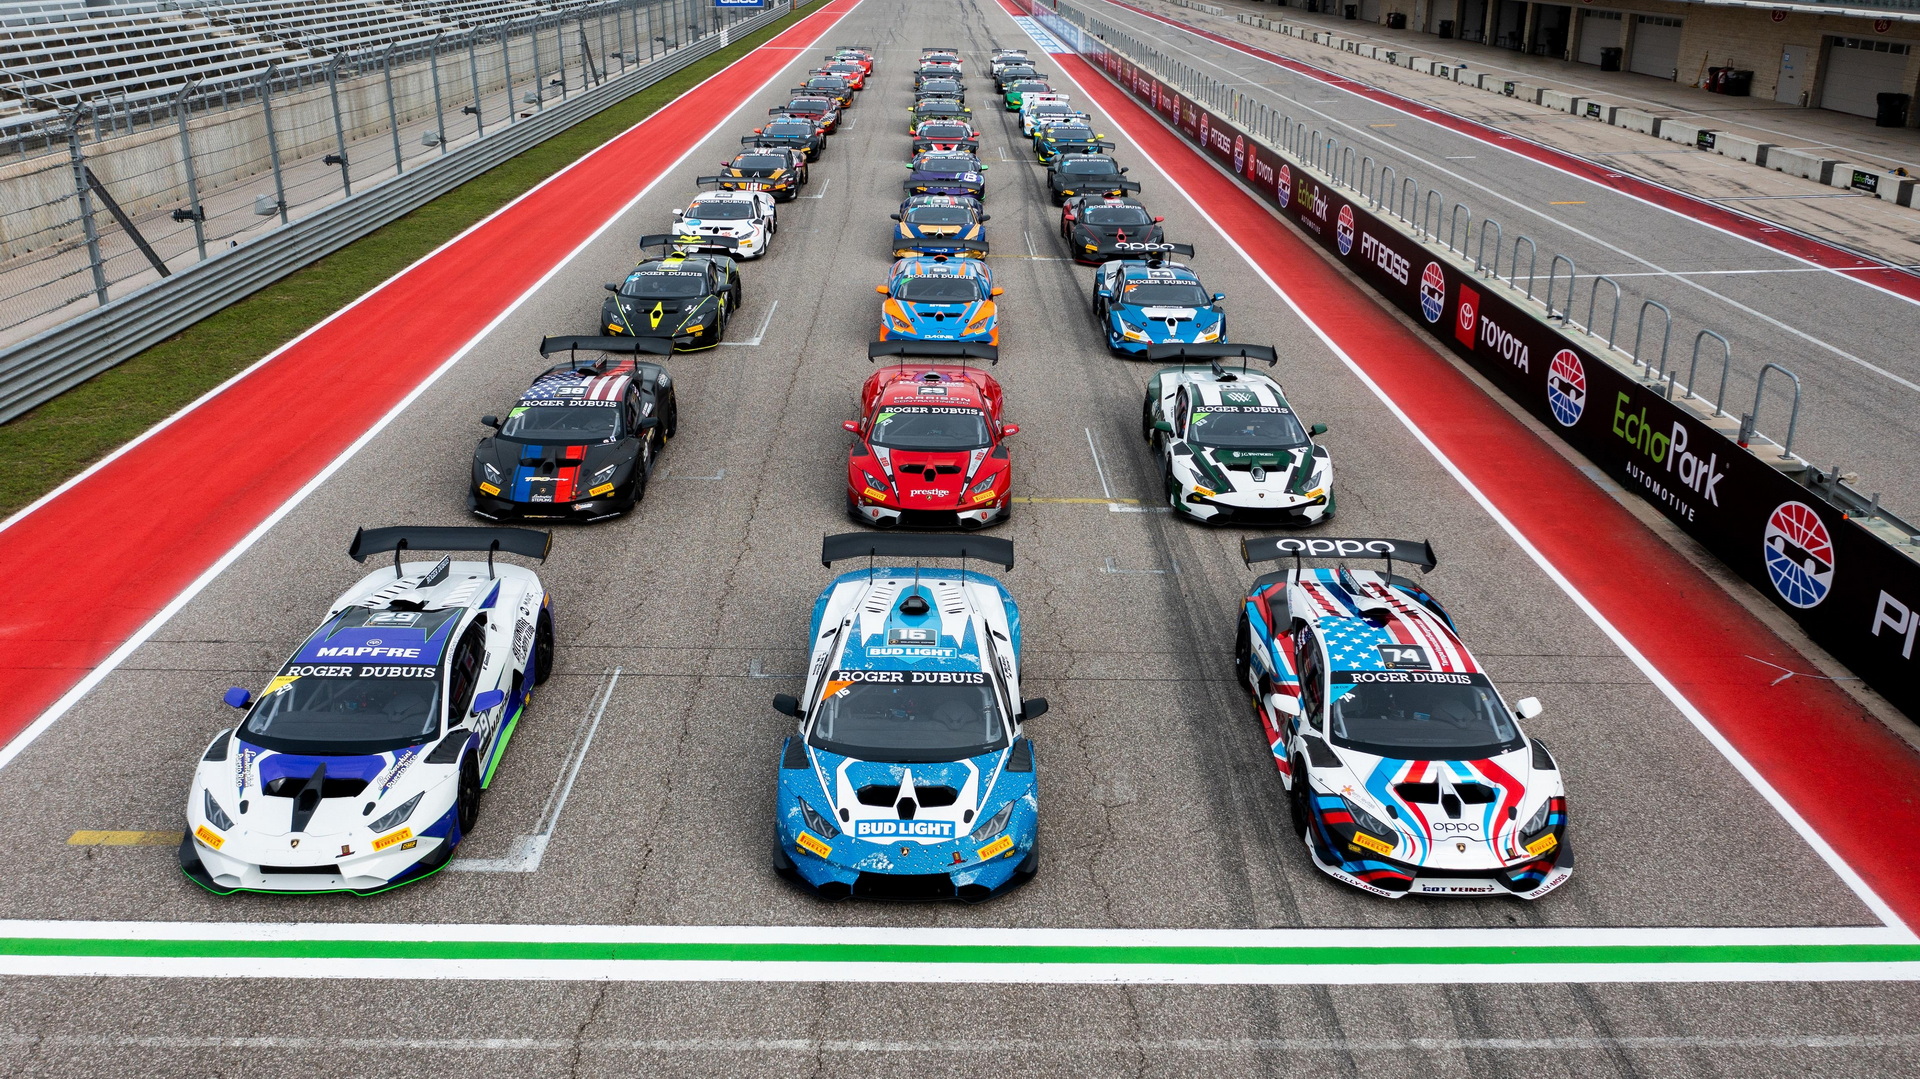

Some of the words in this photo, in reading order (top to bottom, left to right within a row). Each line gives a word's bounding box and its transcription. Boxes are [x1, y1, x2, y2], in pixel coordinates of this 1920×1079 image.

[1256, 159, 1274, 185] TOYOTA
[1298, 178, 1328, 222] EchoPark
[1301, 216, 1321, 234] AUTOMOTIVE
[1115, 242, 1175, 250] oppo
[1480, 315, 1529, 374] TOYOTA
[931, 407, 978, 415] DUBUIS
[1613, 391, 1724, 508] EchoPark
[910, 488, 950, 497] prestige
[1625, 460, 1695, 522] AUTOMOTIVE
[1276, 538, 1395, 556] oppo
[374, 612, 414, 622] 29
[1871, 589, 1920, 661] PI
[898, 629, 927, 640] 16
[316, 647, 421, 658] MAPFRE
[906, 648, 953, 657] LIGHT
[1382, 648, 1421, 662] 74
[286, 666, 353, 677] ROGER
[359, 666, 436, 678] DUBUIS
[837, 672, 904, 683] ROGER
[911, 673, 984, 684] DUBUIS
[1351, 673, 1408, 683] ROGER
[1413, 673, 1472, 684] DUBUIS
[275, 683, 293, 696] 29
[835, 687, 851, 699] 16
[1339, 692, 1356, 702] 74
[236, 753, 244, 773] Puerto
[378, 749, 413, 791] Lamborghini
[387, 766, 406, 789] Puerto
[402, 754, 418, 772] Rico
[236, 773, 245, 788] Rico
[858, 822, 898, 835] BUD
[899, 822, 952, 836] LIGHT
[1433, 822, 1479, 833] oppo
[197, 828, 222, 847] PIRELLI
[375, 830, 409, 849] PIRELLI
[800, 835, 828, 855] PIRELLI
[1357, 834, 1390, 853] PIRELLI
[1530, 836, 1555, 854] PIRELLI
[981, 838, 1010, 858] PIRELLI
[1332, 872, 1391, 897] KELLY-MOSS
[1530, 873, 1568, 898] KELLY-MOSS
